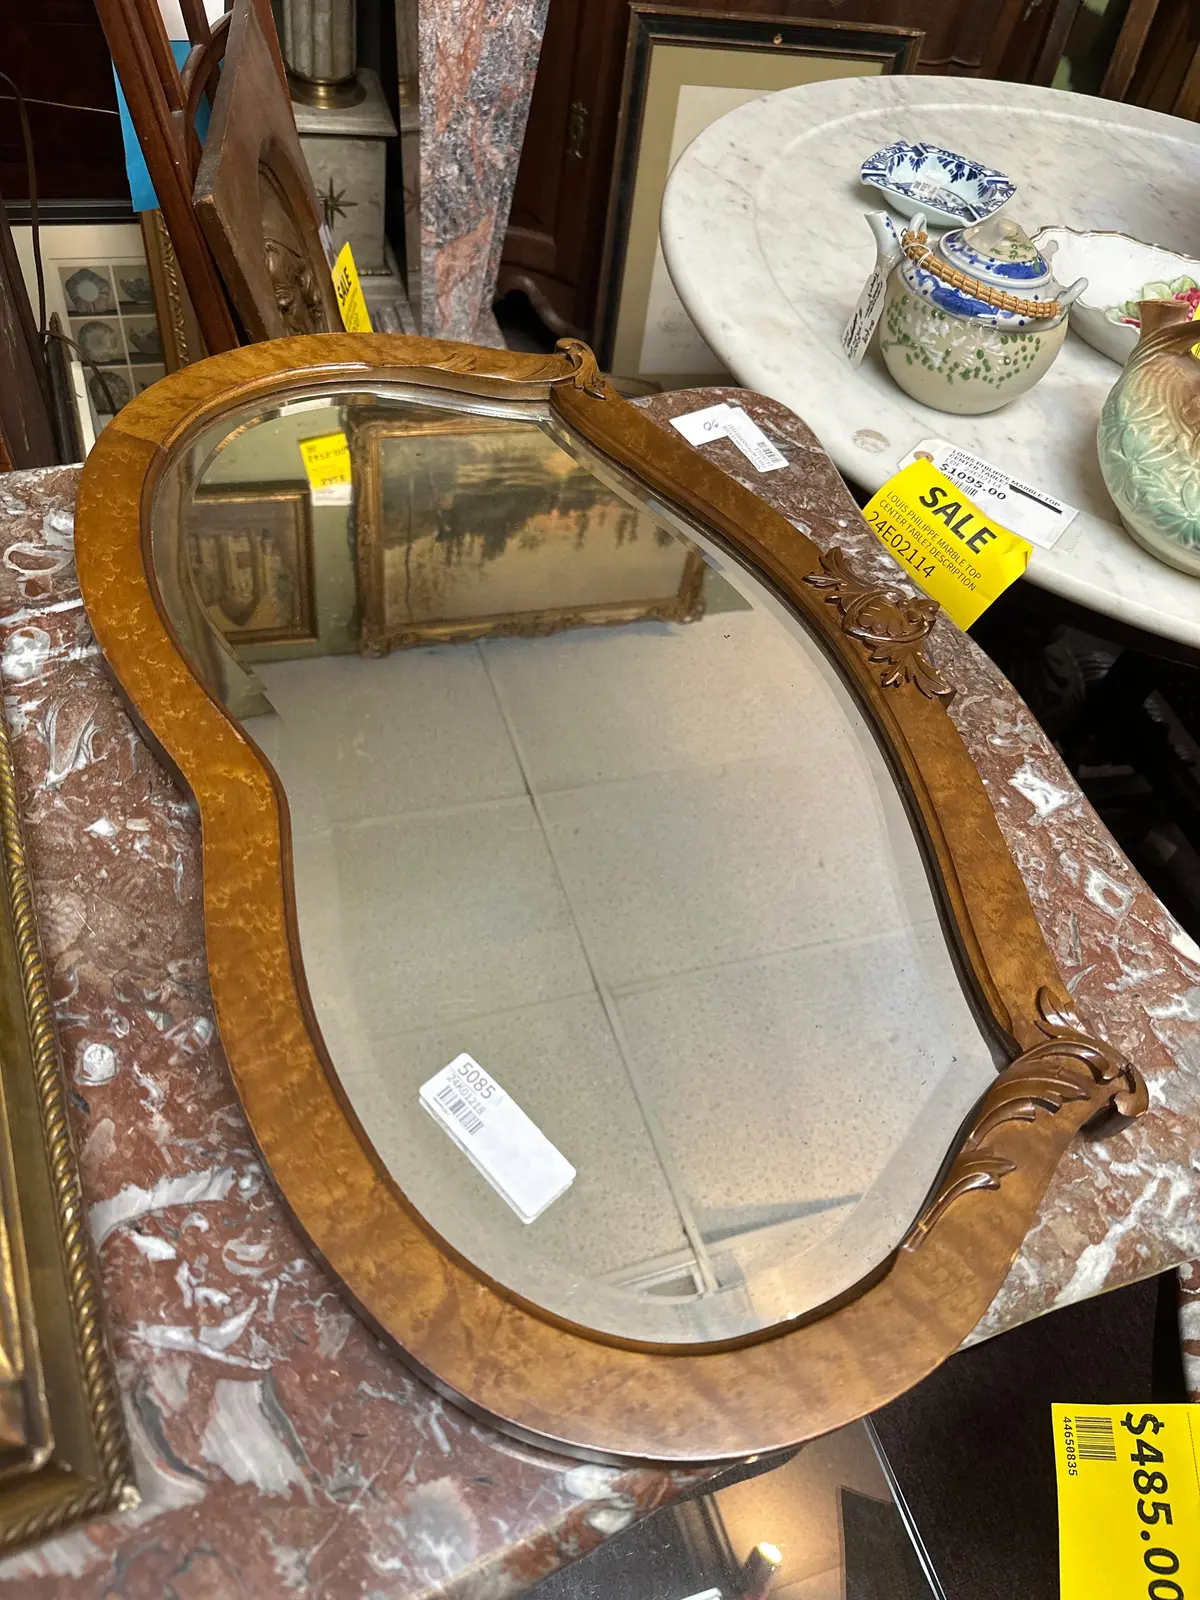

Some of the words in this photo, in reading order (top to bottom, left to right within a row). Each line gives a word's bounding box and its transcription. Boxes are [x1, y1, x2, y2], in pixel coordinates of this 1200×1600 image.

[337, 266, 352, 307] SALE
[939, 463, 1006, 500] $1095.00
[948, 454, 979, 470] CENTER
[952, 449, 976, 463] LOUIS
[976, 461, 1011, 481] PHILIPPE
[1010, 480, 1043, 500] MARBLE
[1044, 497, 1061, 507] TOP
[868, 511, 936, 579] 24E02114
[879, 499, 908, 527] CENTER
[905, 524, 931, 549] TABLE?
[929, 547, 977, 592] DESCRIPTION
[886, 491, 910, 512] LOUIS
[907, 509, 939, 540] PHILIPPE
[937, 538, 967, 566] MARBLE
[964, 563, 981, 579] TOP
[918, 486, 997, 555] SALE
[457, 1062, 496, 1100] 5085
[1063, 1416, 1078, 1476] 44650835
[1120, 1411, 1185, 1600] $485.00
